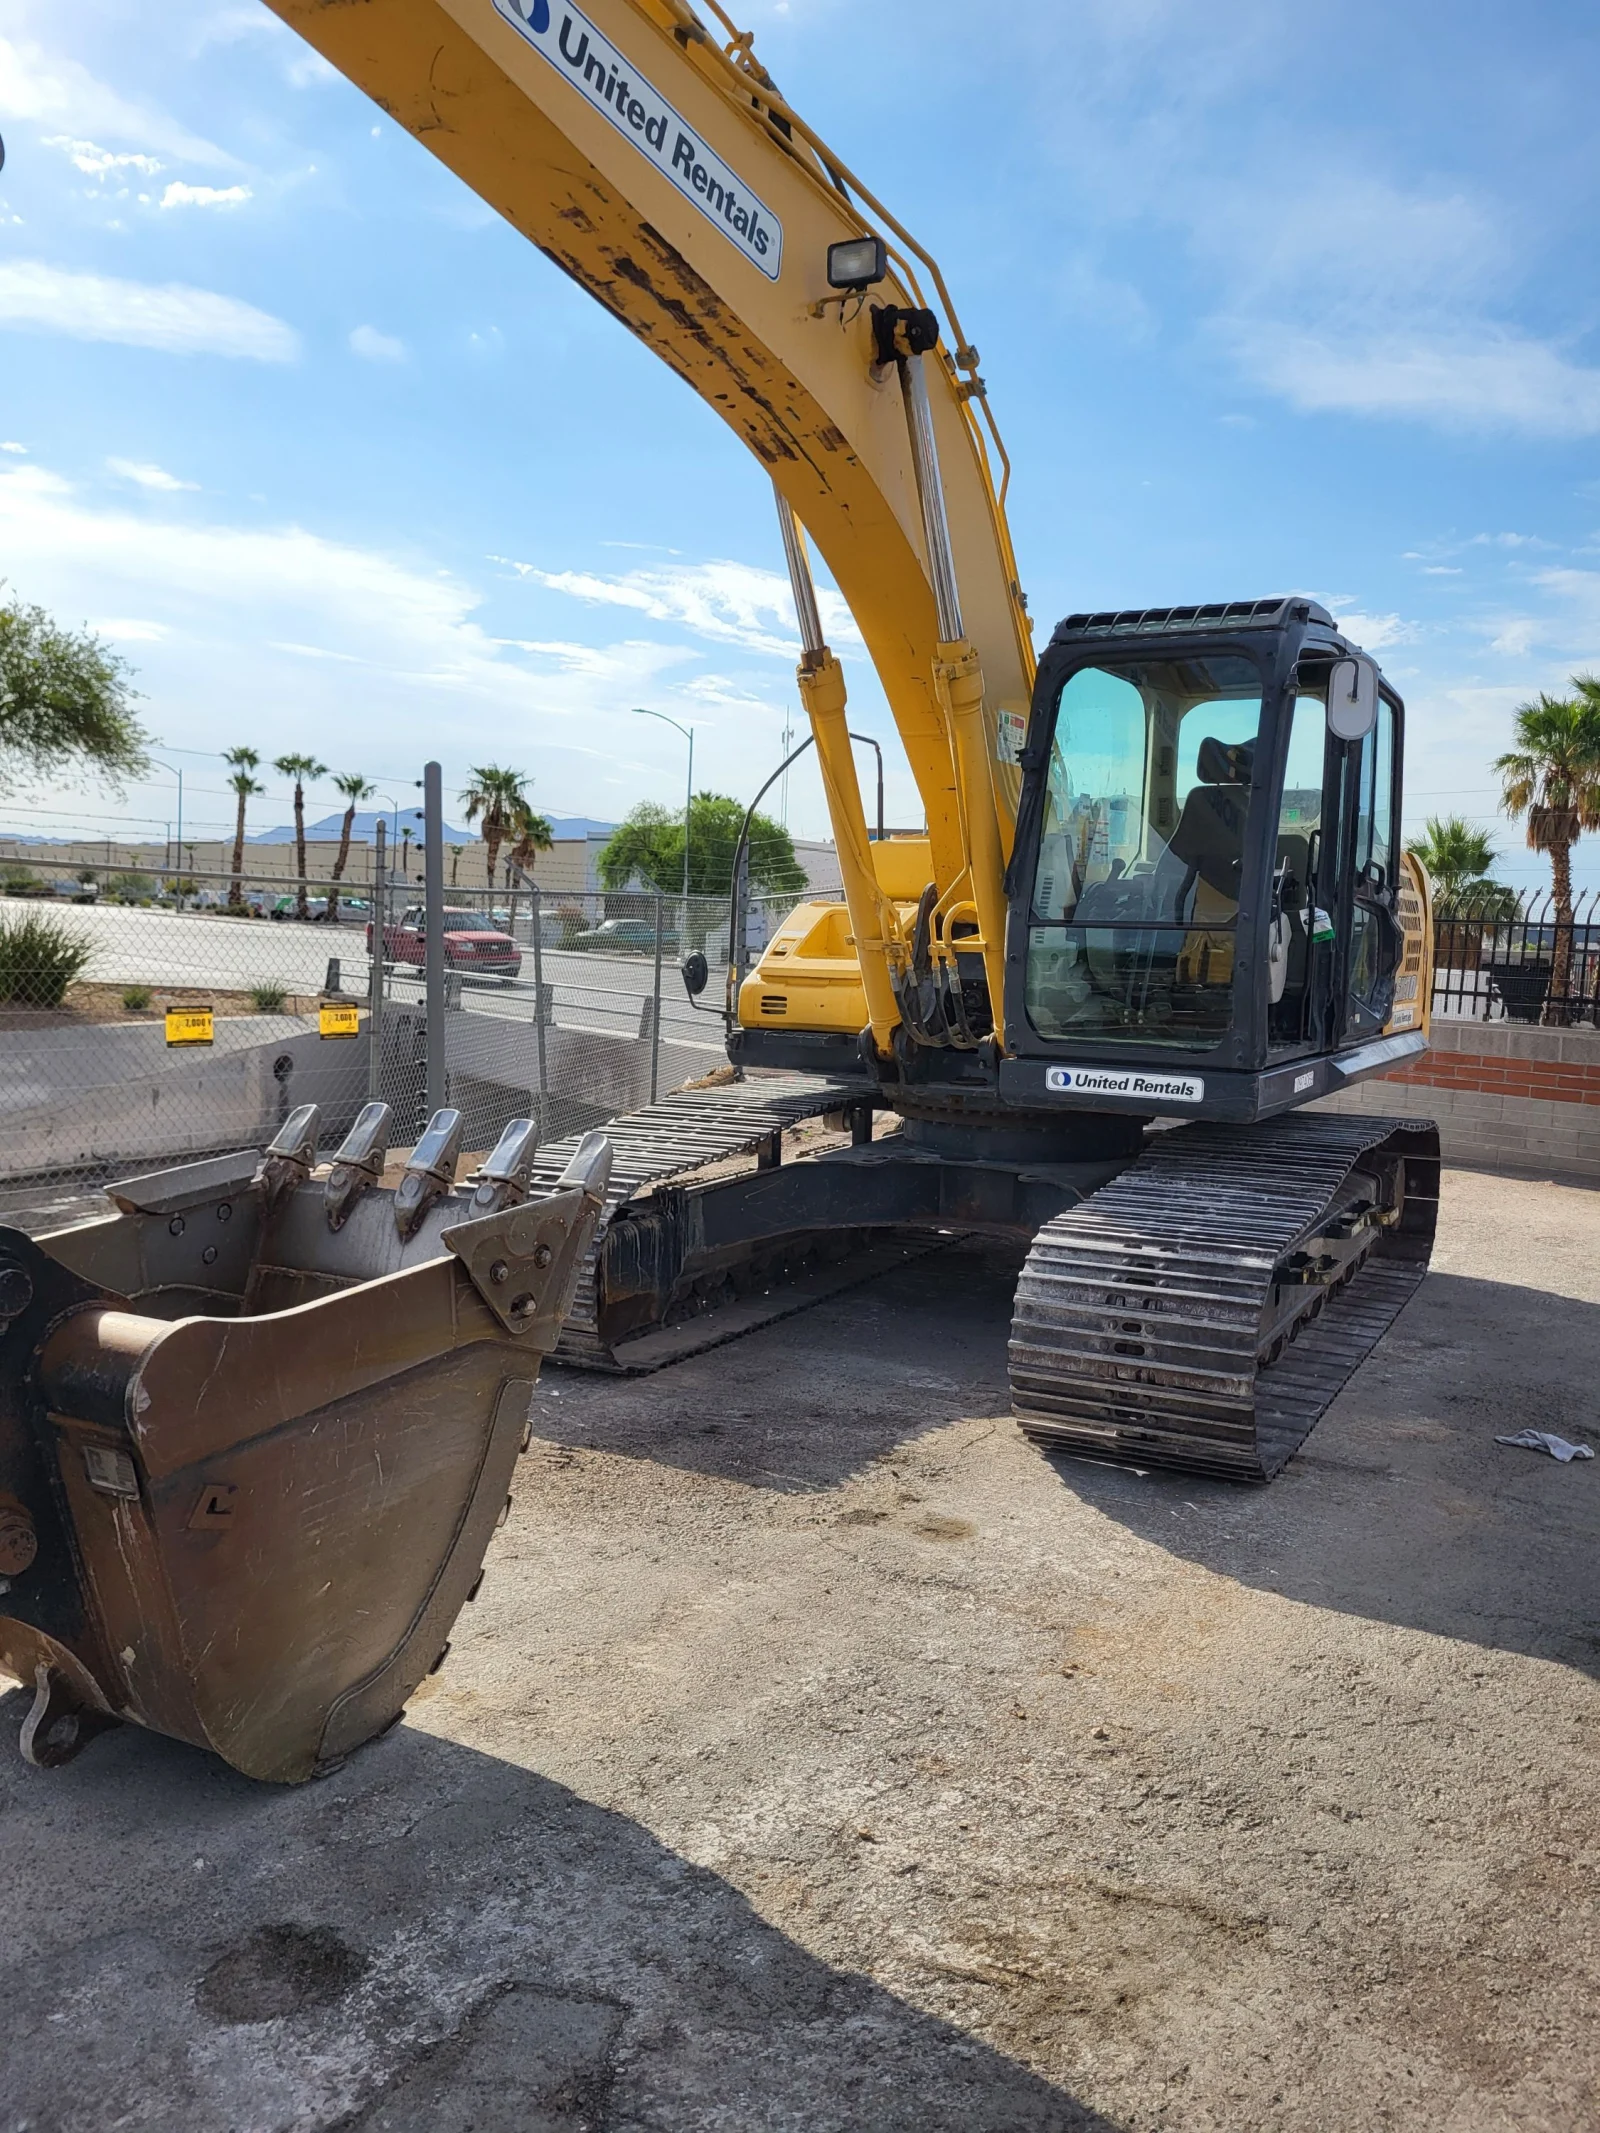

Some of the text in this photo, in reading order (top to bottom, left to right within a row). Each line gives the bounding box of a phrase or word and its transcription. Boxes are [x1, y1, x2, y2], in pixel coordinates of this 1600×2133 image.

[558, 14, 768, 255] United Rentals
[1075, 1073, 1195, 1096] United Rentals
